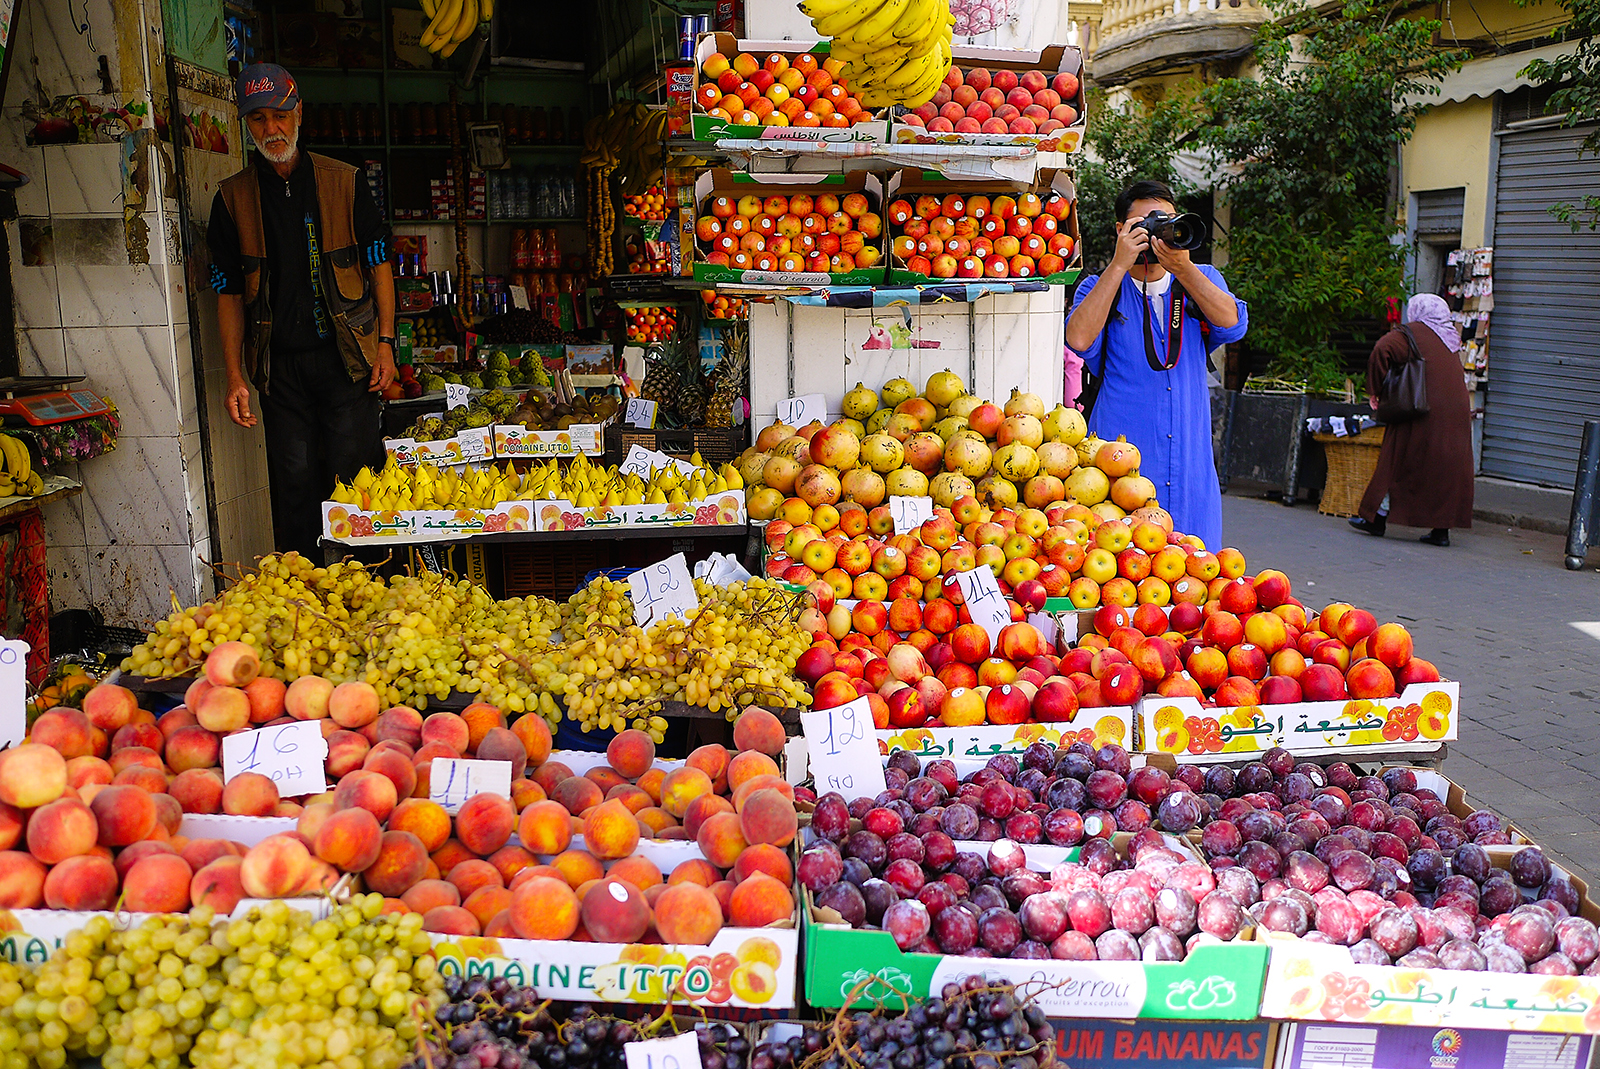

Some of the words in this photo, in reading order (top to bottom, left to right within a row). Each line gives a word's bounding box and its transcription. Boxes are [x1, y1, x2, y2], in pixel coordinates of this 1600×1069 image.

[1172, 299, 1181, 329] Canon
[627, 400, 651, 421] 24
[782, 399, 805, 425] 10
[504, 444, 545, 452] DOMAINE
[548, 443, 569, 451] ITTO
[372, 515, 417, 534] إطو
[422, 515, 485, 532] ضيعة
[634, 510, 694, 526] ضيعة
[472, 544, 484, 580] QUALIT
[636, 564, 680, 608] 12
[966, 571, 998, 604] 14
[819, 706, 864, 756] 12
[1219, 715, 1285, 744] إطو
[1293, 713, 1384, 737] ضيعة
[236, 725, 300, 772] 16
[438, 956, 597, 989] OMAINE
[618, 965, 712, 995] ITTO
[1045, 998, 1070, 1006] fruits
[1074, 999, 1129, 1008] d'exception
[1368, 983, 1457, 1018] إطو
[1468, 987, 1589, 1018] ضيعة
[1112, 1030, 1260, 1061] BANANAS
